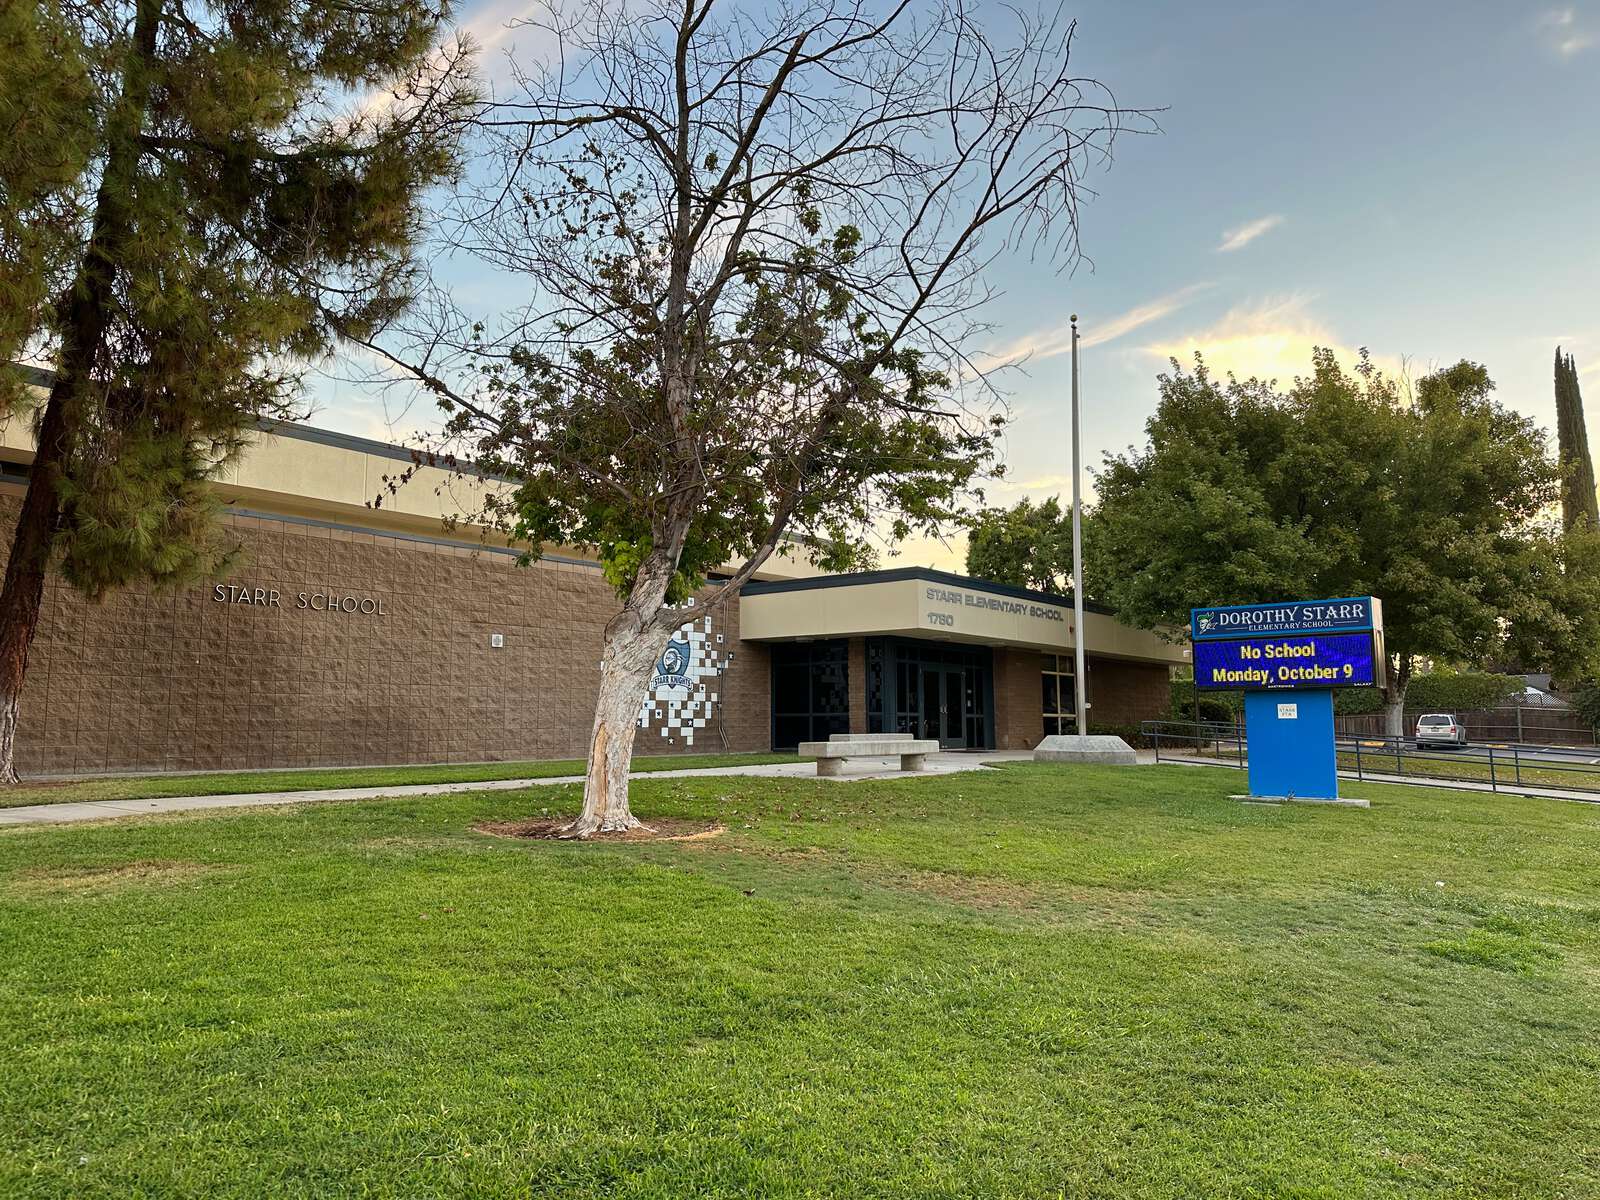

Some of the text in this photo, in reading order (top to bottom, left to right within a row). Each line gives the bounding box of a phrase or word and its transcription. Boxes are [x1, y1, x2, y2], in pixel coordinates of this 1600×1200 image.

[213, 584, 387, 616] STARR SCHOOL
[926, 587, 1064, 622] STARR ELEMENTARY SCHOOL
[1219, 604, 1365, 626] DOROTHY STARR
[1248, 620, 1334, 632] ELEMENTARY SCHOOL
[1240, 641, 1316, 660] No School
[1212, 663, 1354, 685] Monday, October 9
